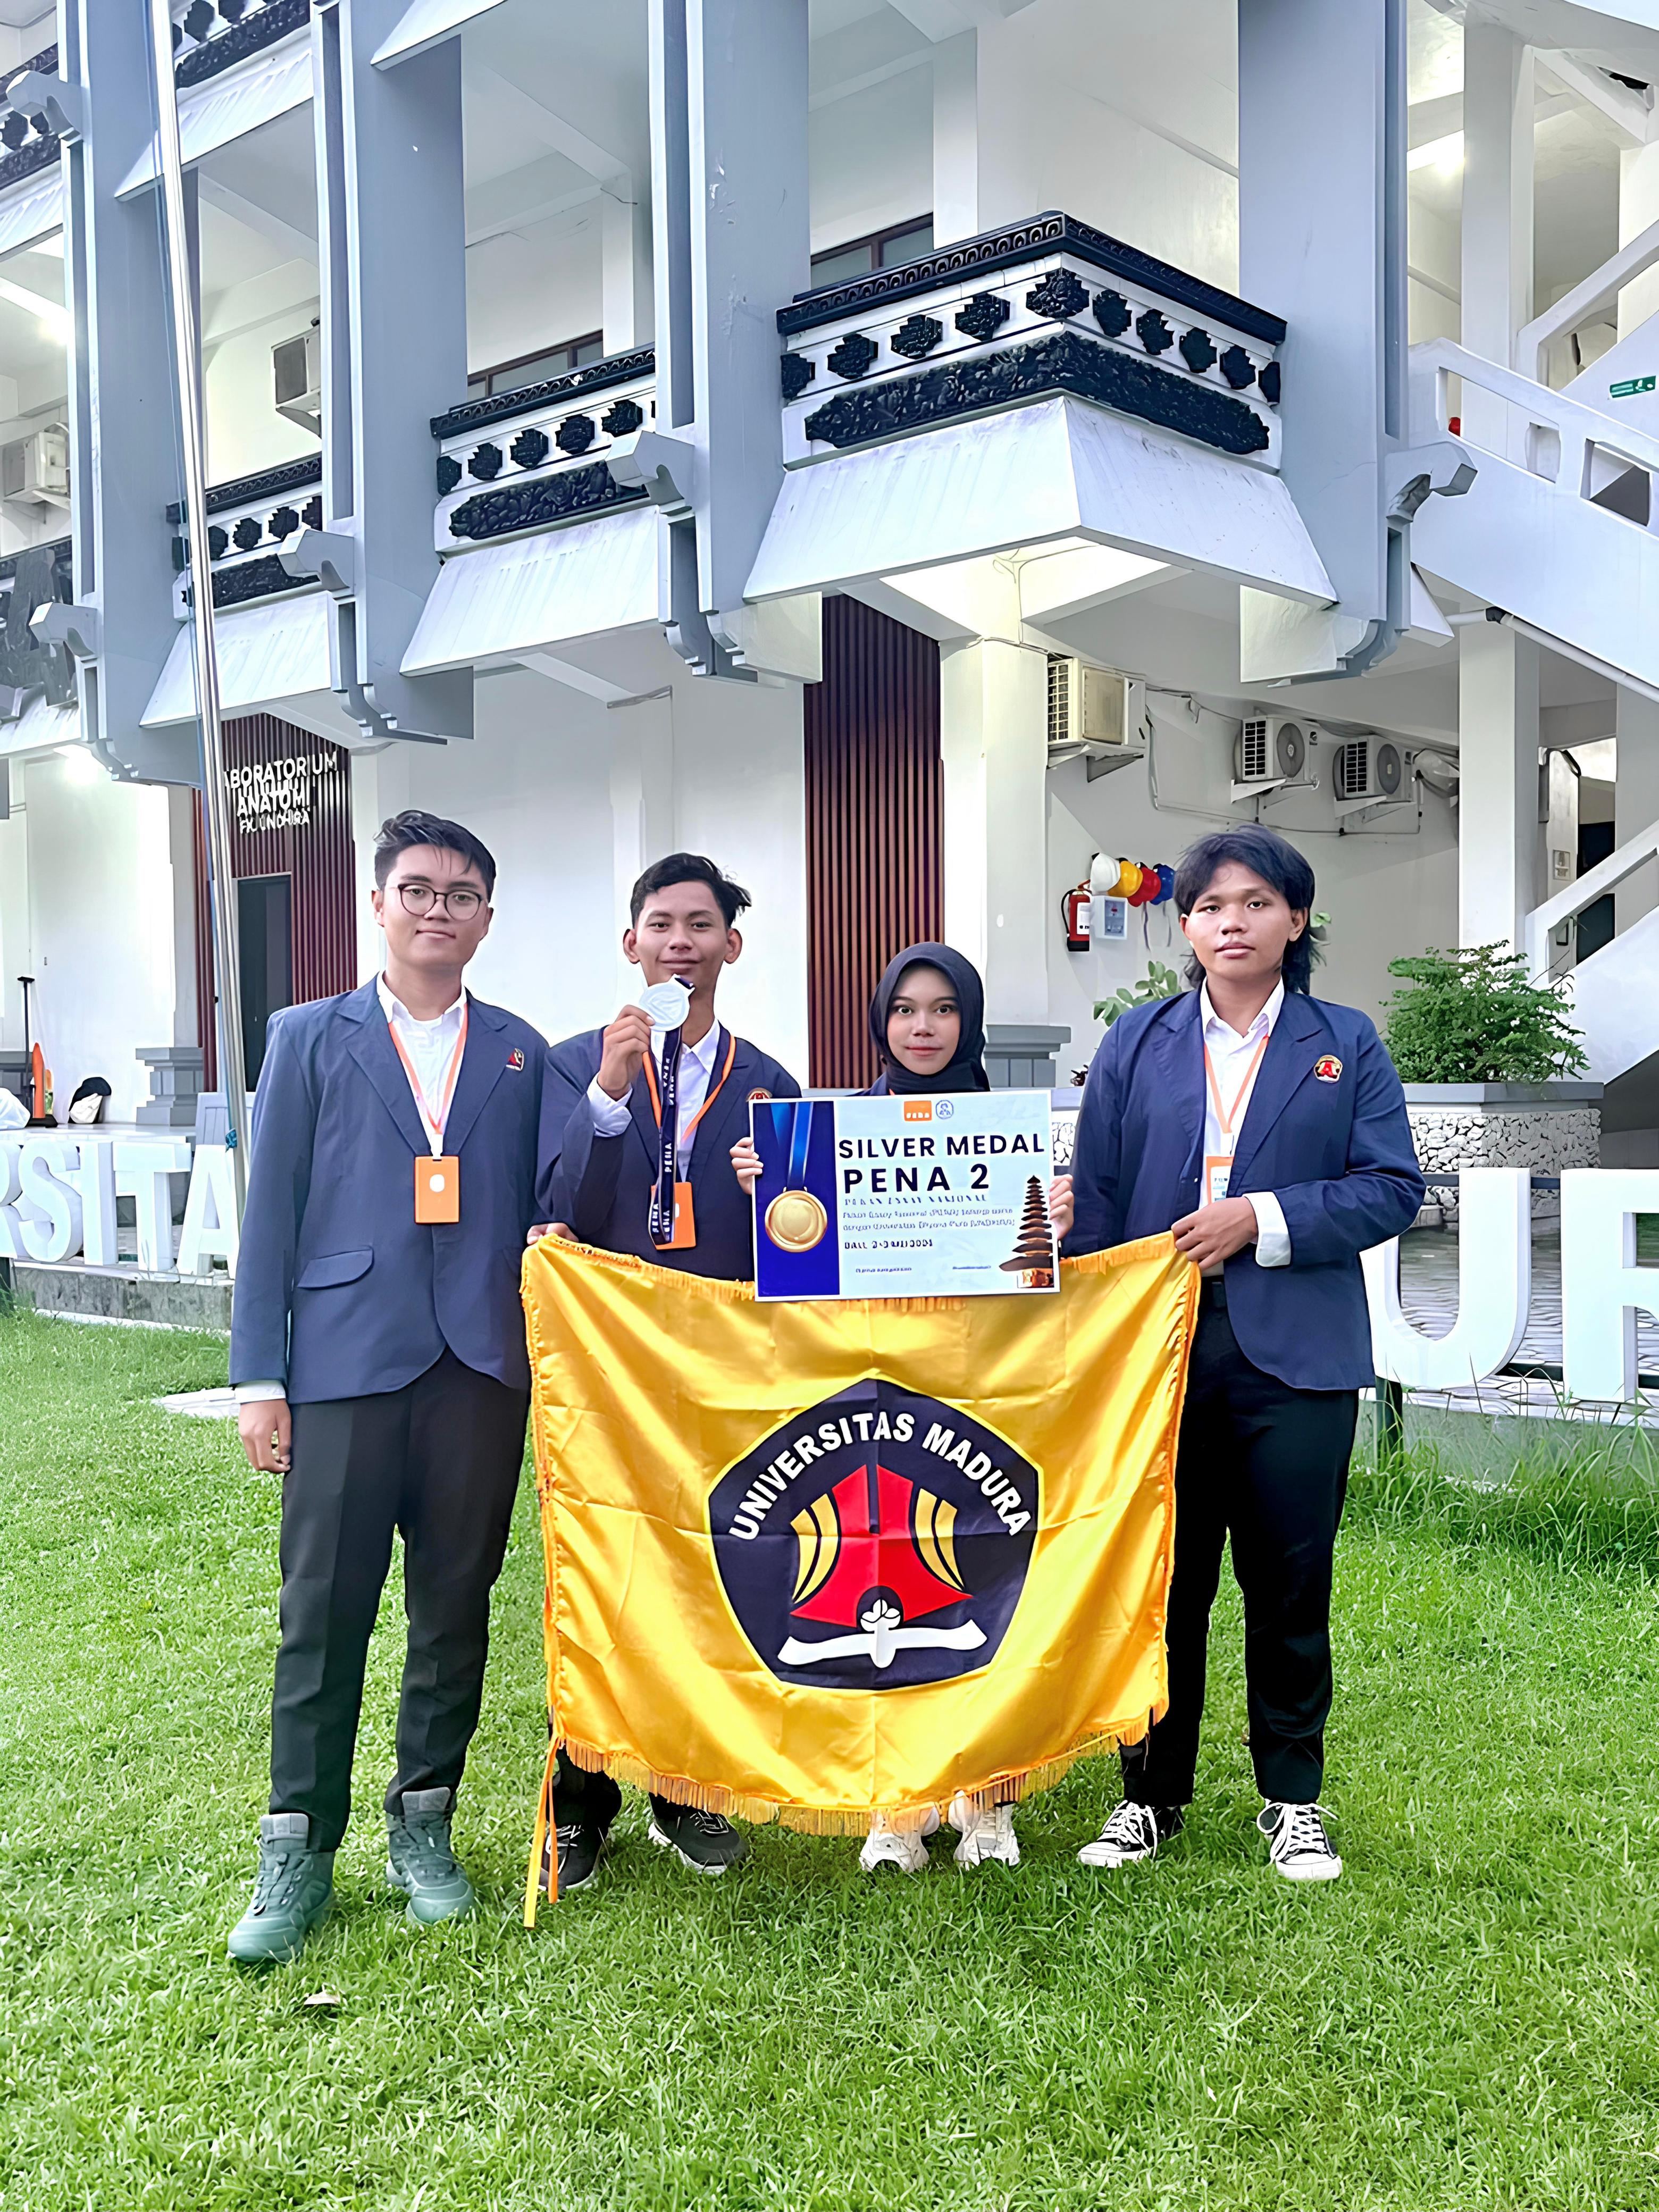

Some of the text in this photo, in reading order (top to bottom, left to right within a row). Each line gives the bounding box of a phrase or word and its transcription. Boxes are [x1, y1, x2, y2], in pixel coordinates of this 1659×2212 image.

[839, 1133, 1045, 1159] SILVER MEDAL
[843, 1163, 990, 1194] PENA 2
[729, 1411, 1032, 1540] UNIVERSITAS MADURA
